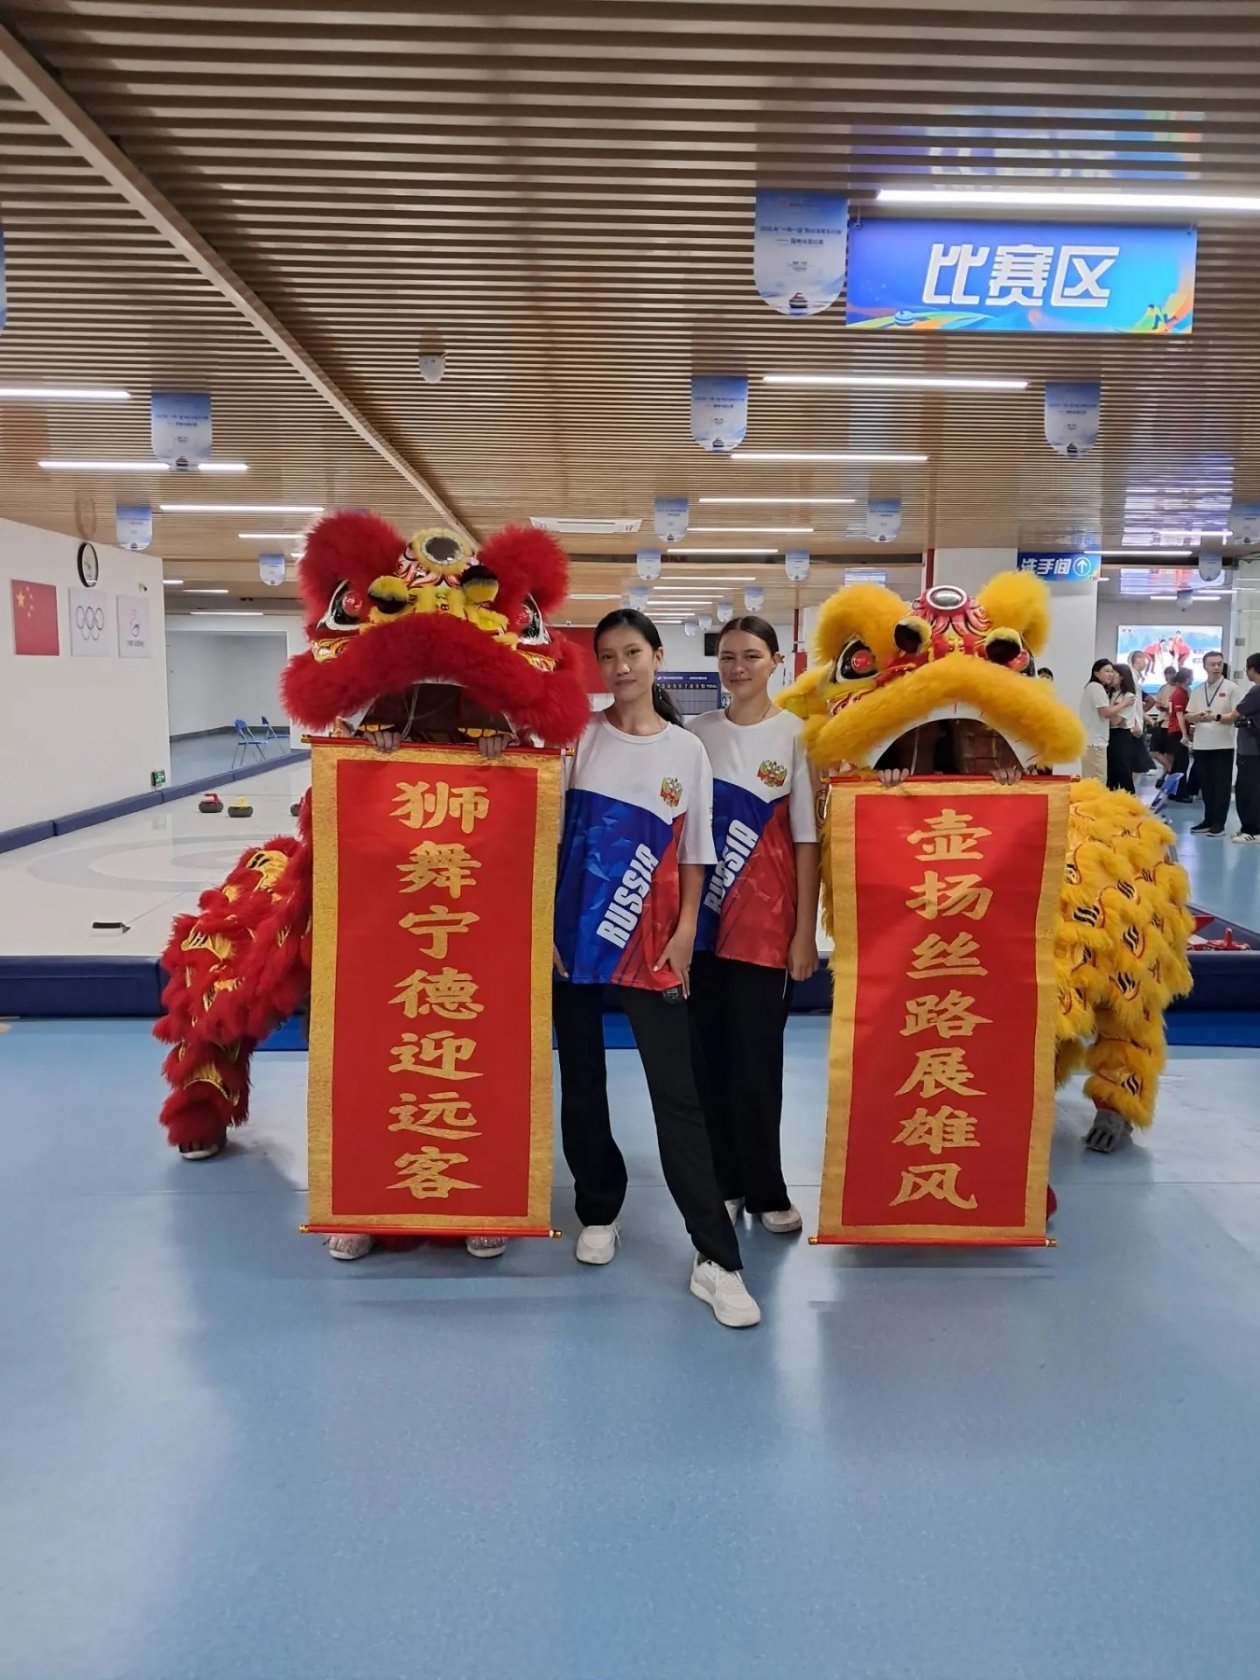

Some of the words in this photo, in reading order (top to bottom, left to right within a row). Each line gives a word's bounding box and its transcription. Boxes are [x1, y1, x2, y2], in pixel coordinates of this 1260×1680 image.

[922, 243, 1120, 307] 比赛区
[385, 781, 490, 1200] 狮舞宁德迎远客
[596, 843, 659, 949] RUSSIA
[889, 808, 994, 1210] 壶扬丝路展雄风
